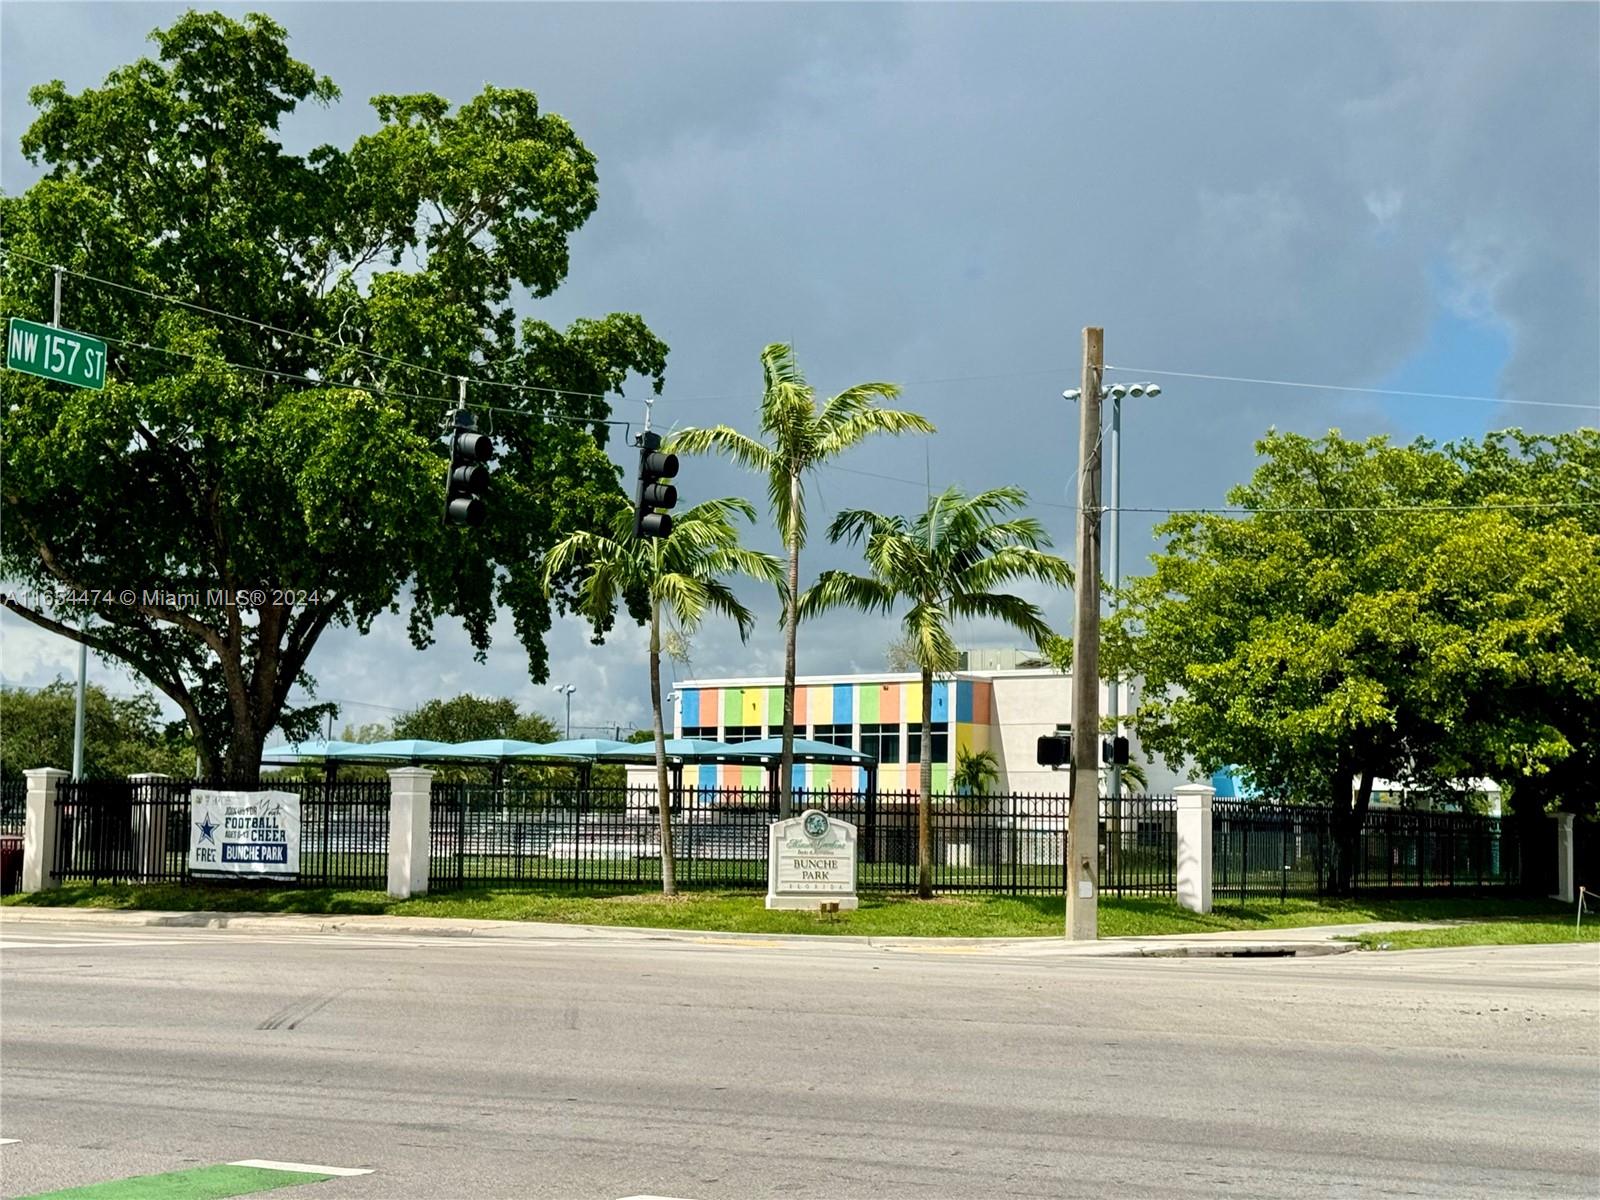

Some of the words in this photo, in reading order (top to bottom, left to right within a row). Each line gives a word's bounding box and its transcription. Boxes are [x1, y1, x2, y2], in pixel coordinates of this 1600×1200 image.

[11, 328, 39, 364] NW
[43, 334, 81, 376] 157
[84, 347, 104, 380] ST
[246, 806, 258, 816] FOR
[225, 817, 279, 829] FOOTBALL
[251, 829, 286, 842] CHEER
[196, 847, 217, 863] FREE
[226, 846, 260, 860] BUNCHE
[261, 845, 284, 861] PARK
[793, 859, 838, 869] BUNCHE
[802, 870, 830, 880] PARK
